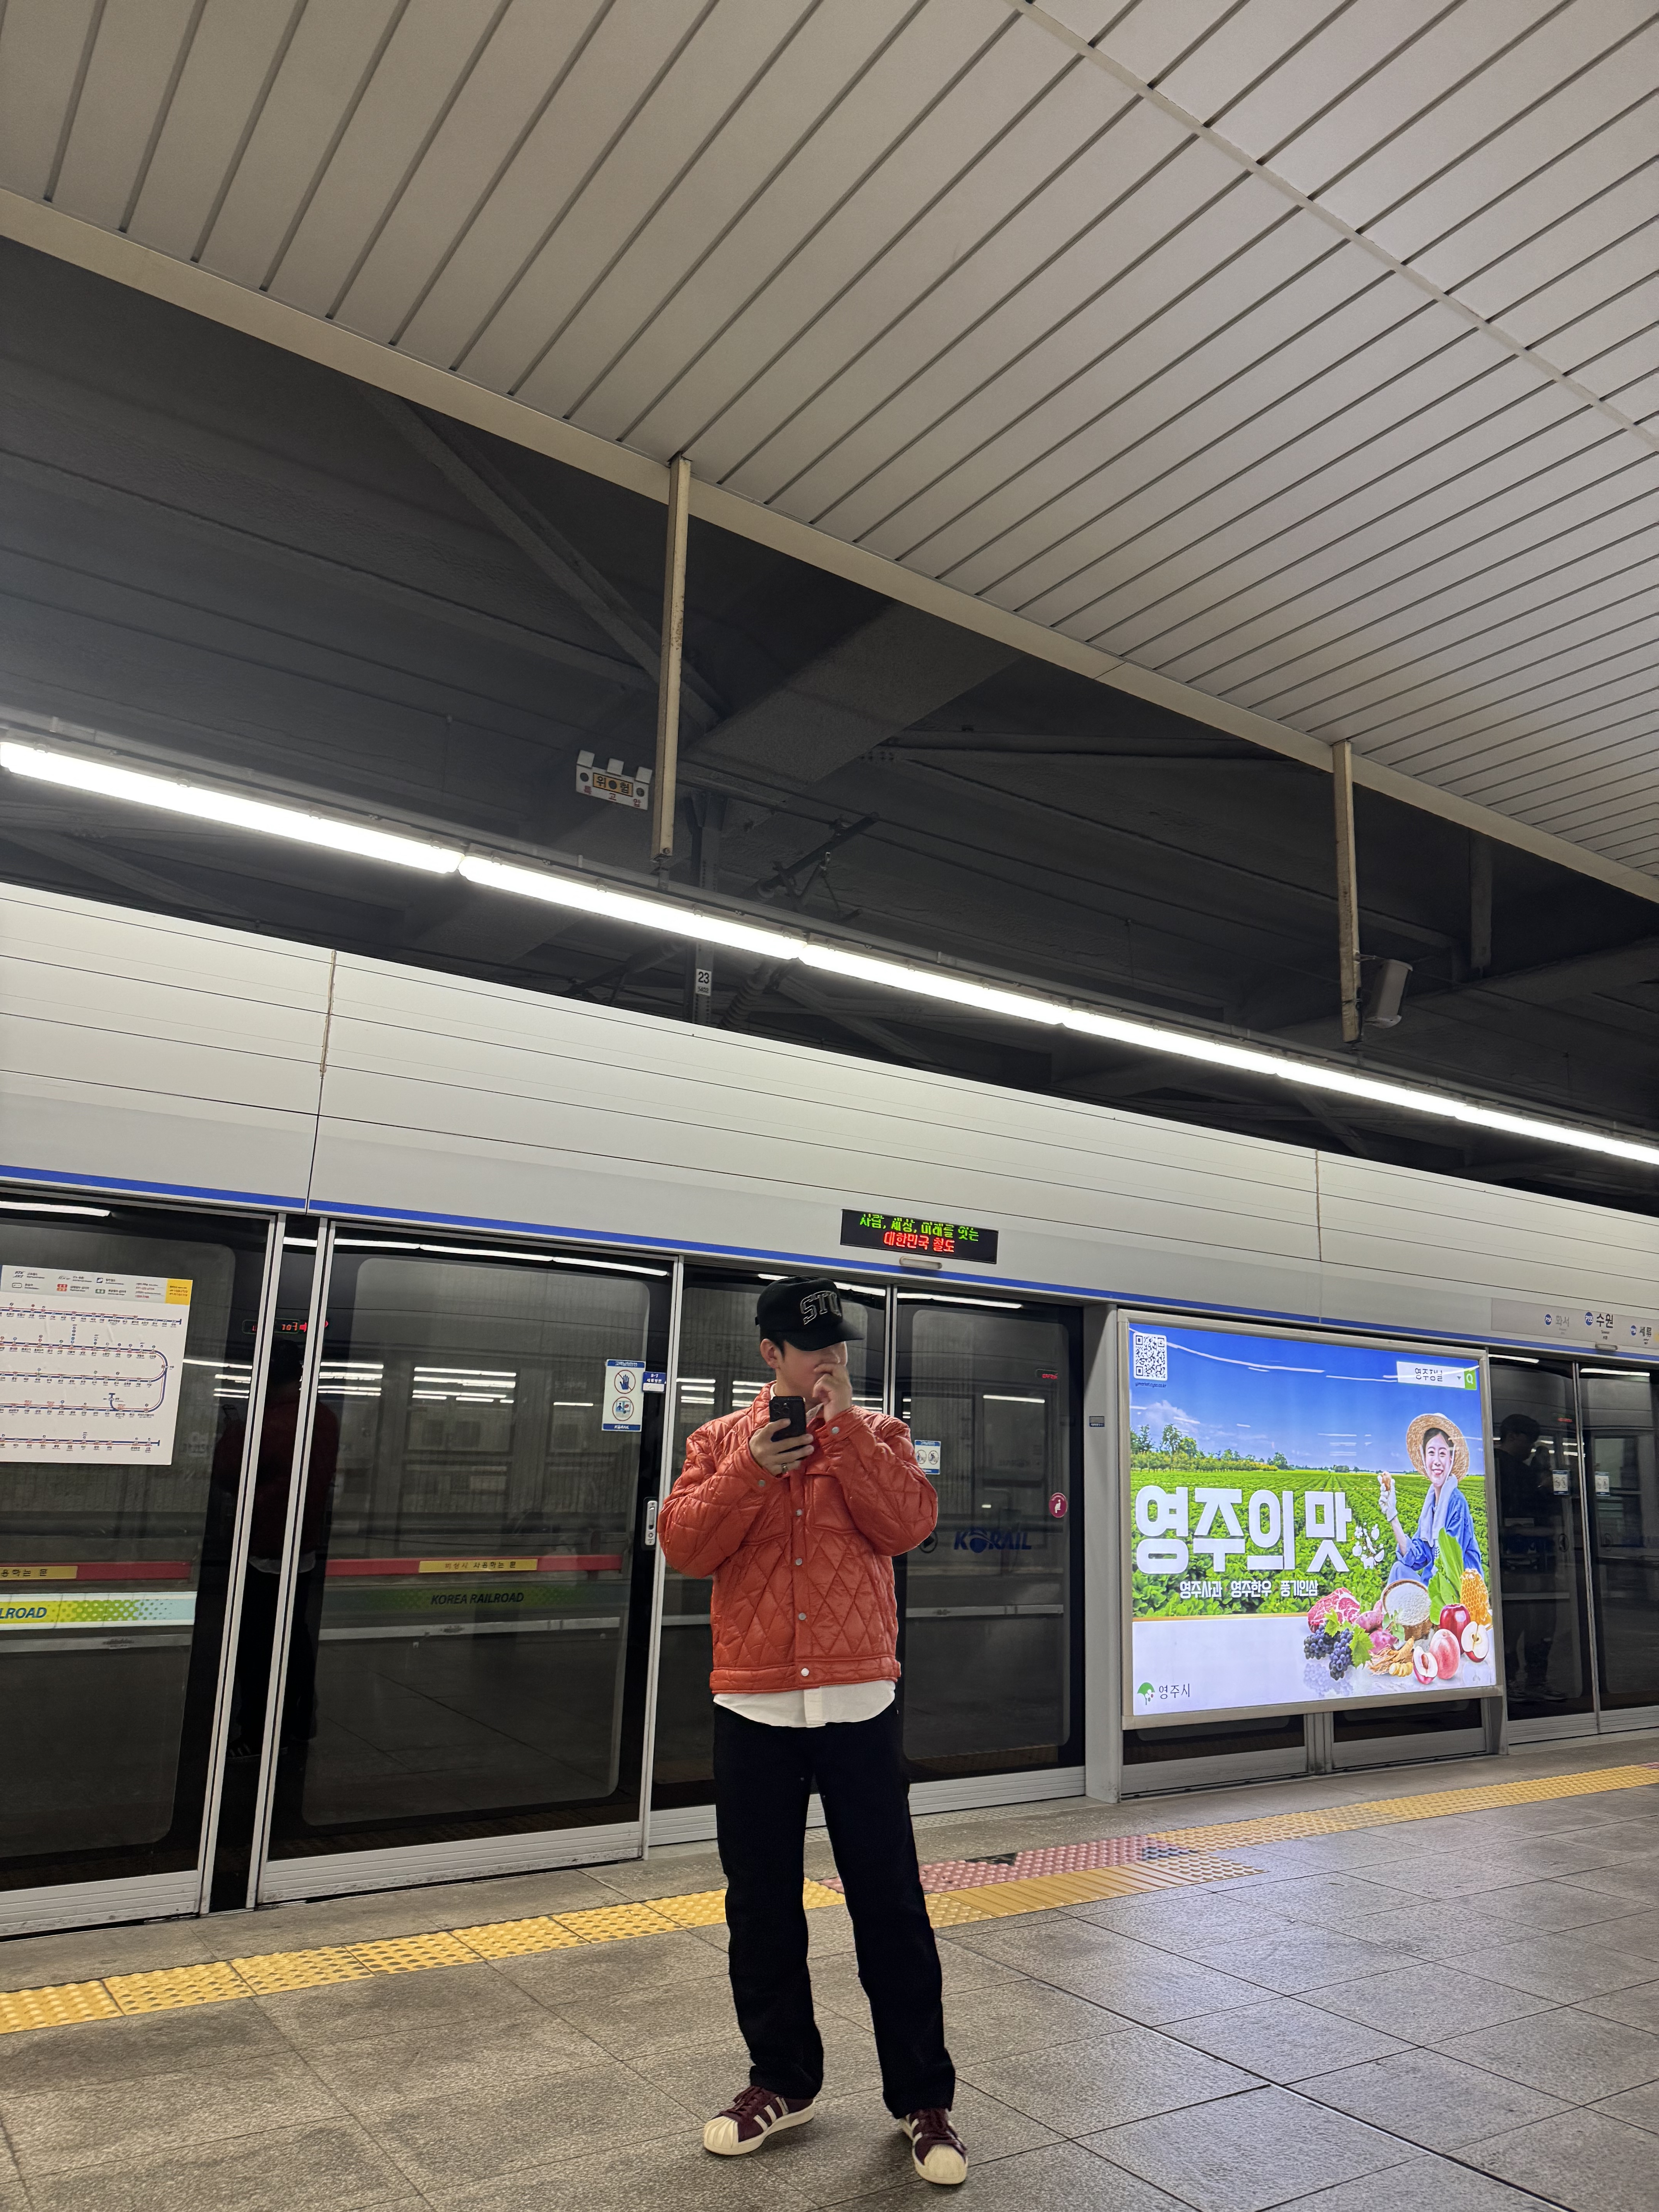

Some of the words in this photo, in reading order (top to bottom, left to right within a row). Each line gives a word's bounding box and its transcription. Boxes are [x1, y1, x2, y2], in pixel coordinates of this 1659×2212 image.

[698, 971, 709, 984] 23
[884, 1231, 929, 1250] 대한민국
[933, 1237, 955, 1253] 철도
[1596, 1313, 1613, 1328] 수원
[1415, 1368, 1443, 1382] 영주장날
[1135, 1485, 1295, 1574] 영주의
[1305, 1491, 1352, 1572] 맛
[954, 1527, 1032, 1553] KORAIL
[1180, 1581, 1223, 1599] 영주사과
[1231, 1580, 1272, 1598] 영주한우
[1280, 1580, 1319, 1597] 풍기인삼
[431, 1594, 467, 1605] KOREA
[470, 1592, 524, 1604] RAILROAD
[1159, 1683, 1190, 1699] 영주시
